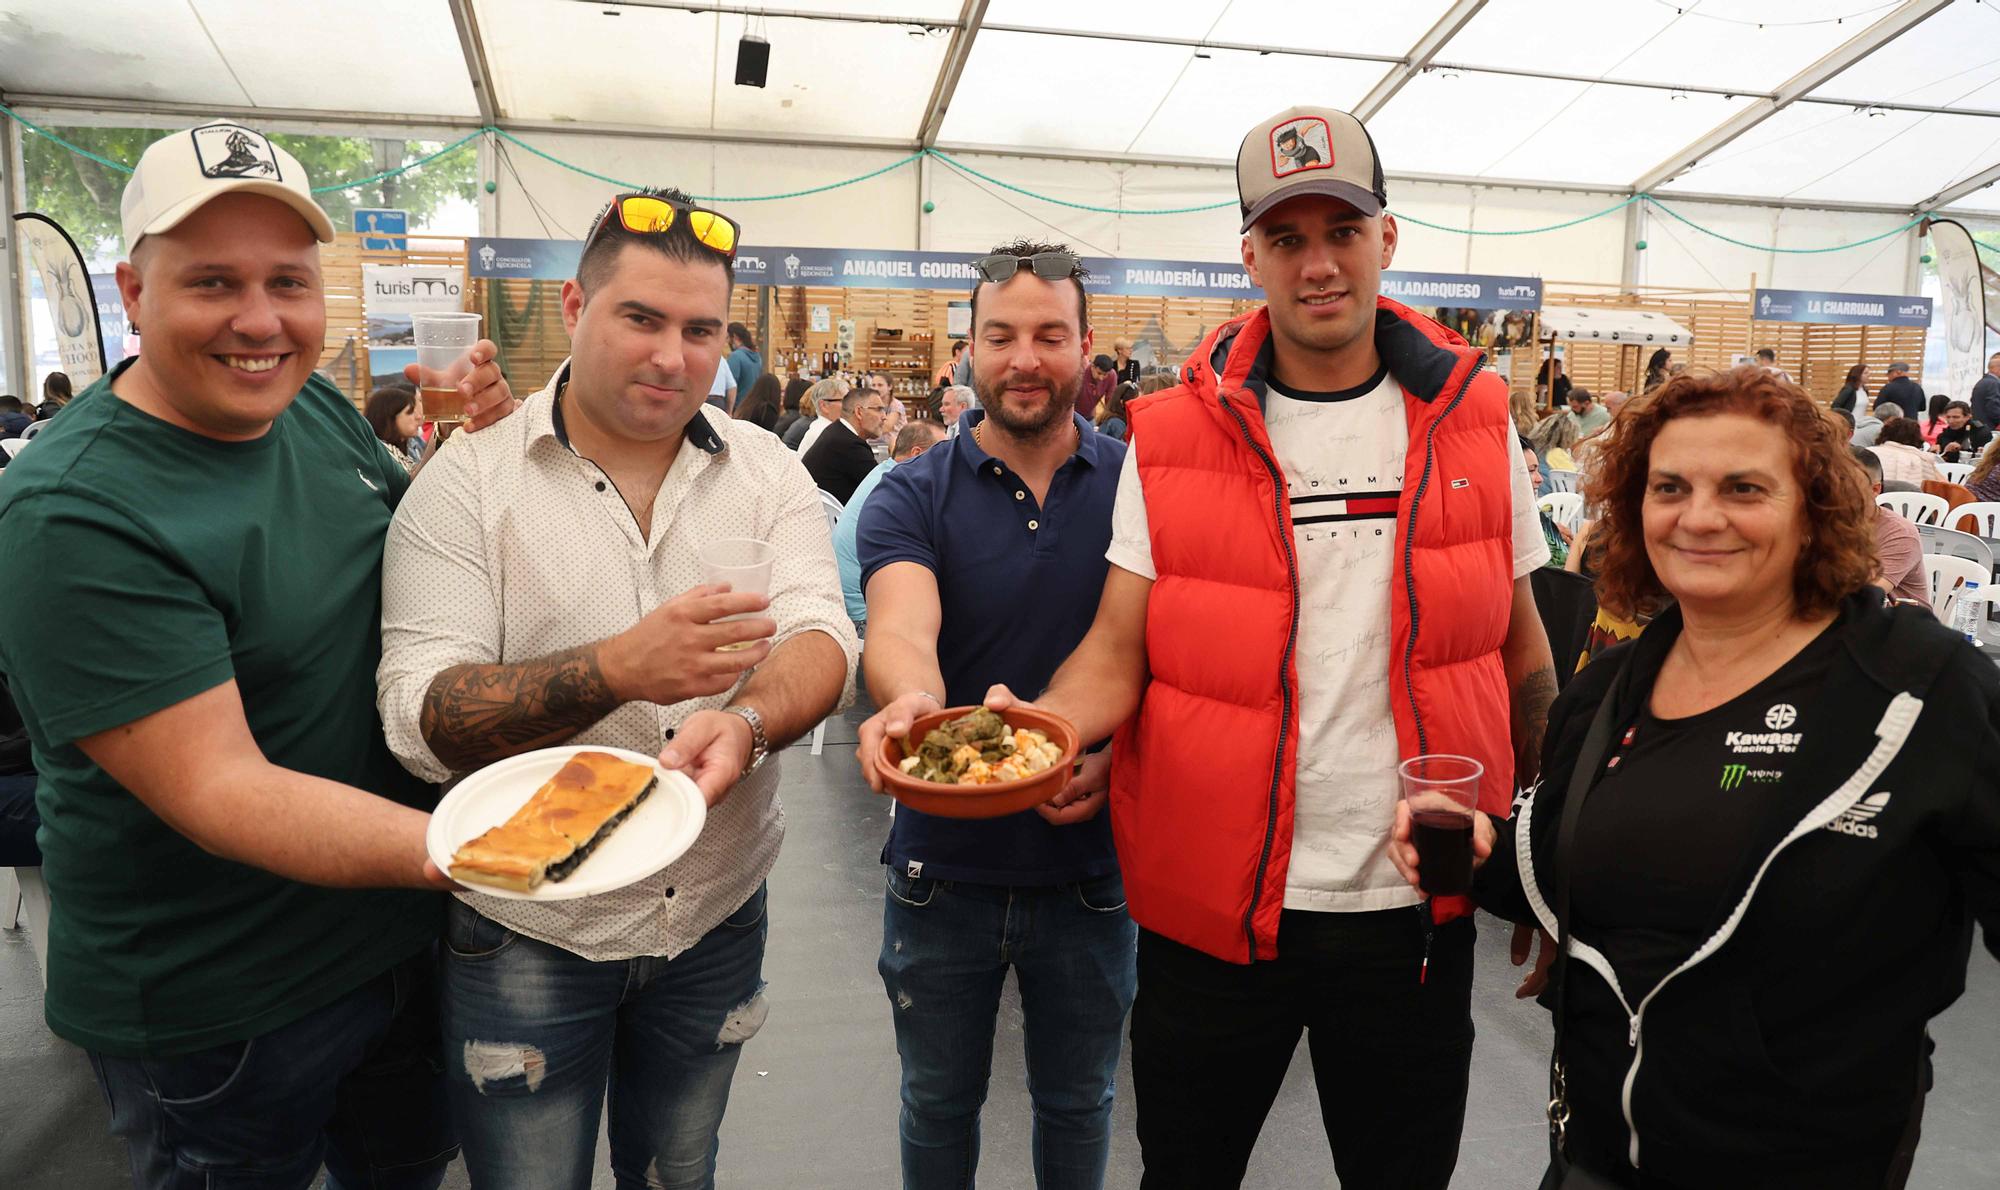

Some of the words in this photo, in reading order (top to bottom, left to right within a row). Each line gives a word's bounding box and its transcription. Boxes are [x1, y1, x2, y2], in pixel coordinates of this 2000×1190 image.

[843, 259, 916, 277] ANAQUEL
[920, 262, 981, 279] GOURM
[1126, 268, 1206, 287] PANADERÍA
[1210, 273, 1251, 289] LUISA
[1380, 280, 1480, 298] PALADARQUESO
[1808, 300, 1820, 314] LA
[1823, 301, 1885, 317] CHARRUANA
[1287, 475, 1402, 489] TOMMY
[1306, 529, 1382, 542] LFIG
[1732, 744, 1775, 754] Racing
[1822, 813, 1879, 840] didas
